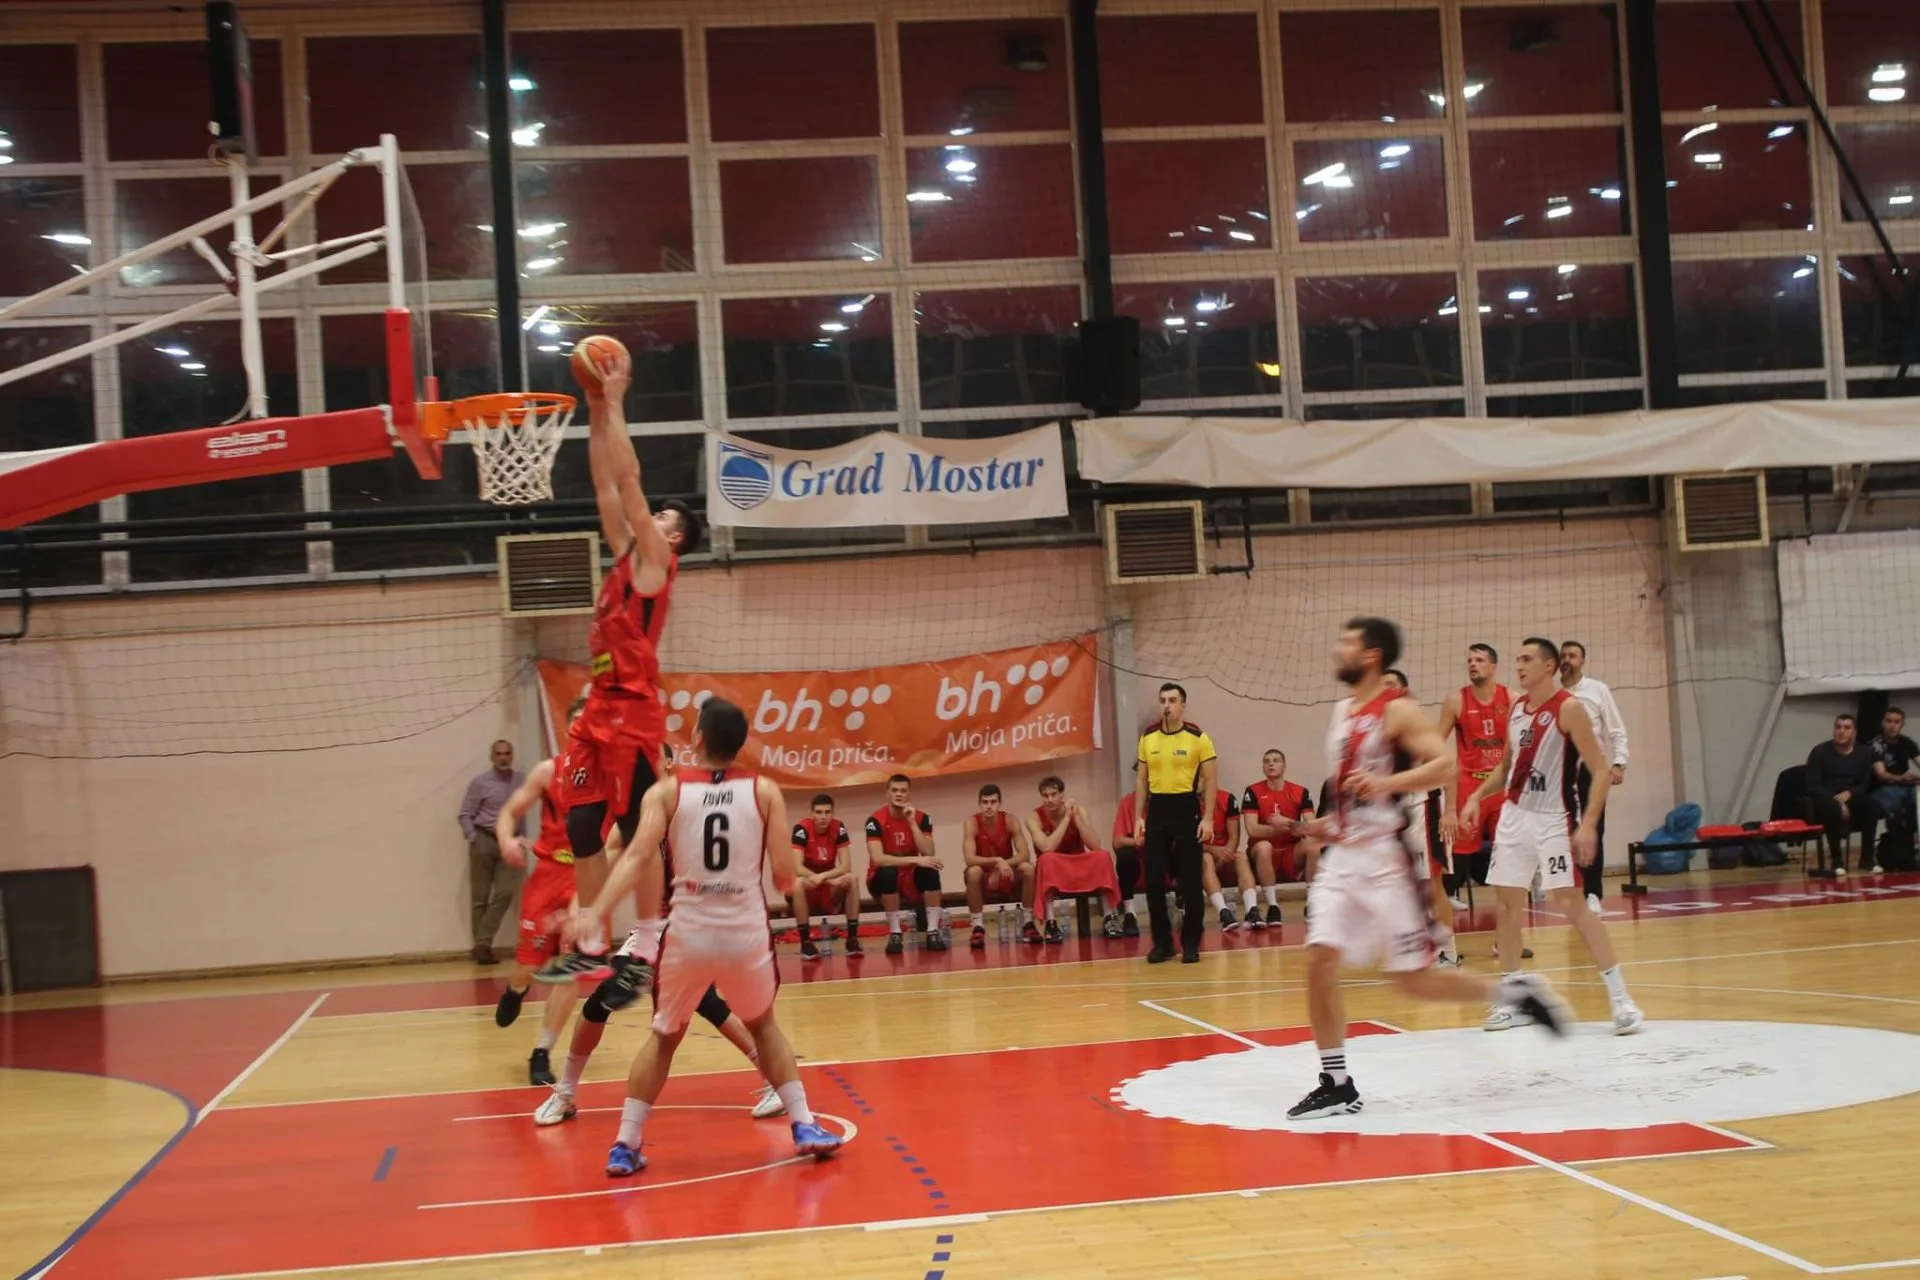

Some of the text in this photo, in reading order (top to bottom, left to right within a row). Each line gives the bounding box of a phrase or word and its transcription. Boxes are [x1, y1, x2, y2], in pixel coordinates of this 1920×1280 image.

[781, 451, 1045, 497] Grad Mostar
[753, 687, 823, 733] bh
[936, 670, 1002, 721] bh
[760, 740, 896, 773] Moja priča.
[945, 713, 1078, 755] Moja priča.
[703, 811, 730, 872] 6
[1548, 855, 1568, 875] 24
